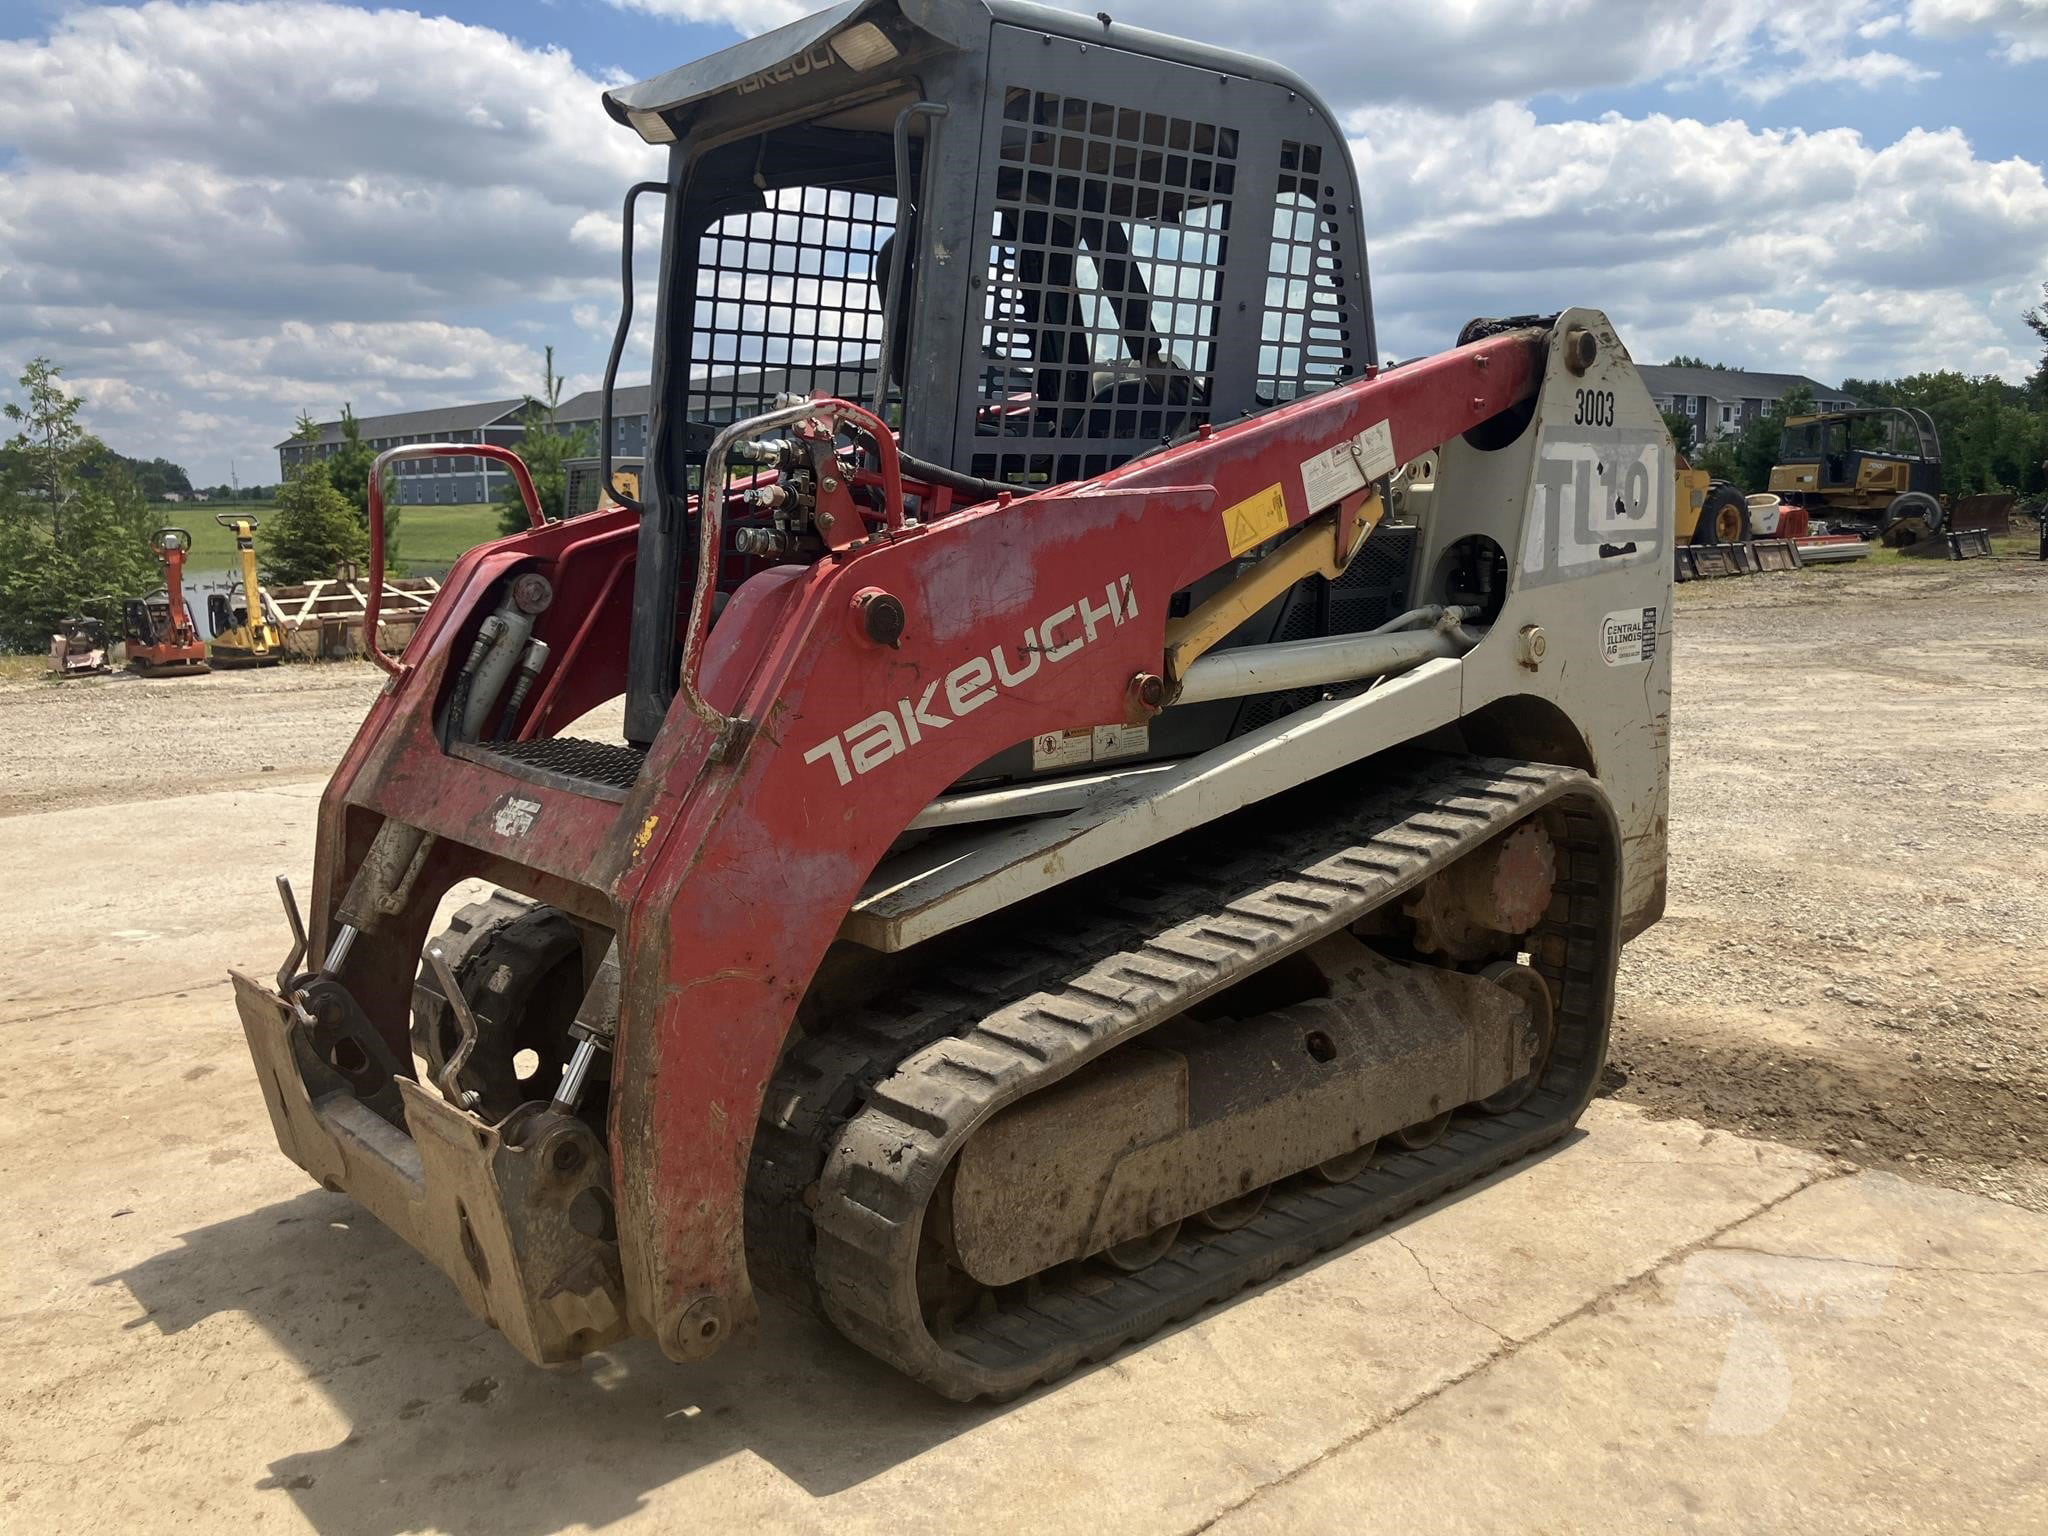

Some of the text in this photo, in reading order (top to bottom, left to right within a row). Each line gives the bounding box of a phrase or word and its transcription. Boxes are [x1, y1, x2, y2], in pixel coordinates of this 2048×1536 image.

[1575, 388, 1615, 427] 3003
[1607, 623, 1642, 636] CENTRAL
[1607, 632, 1642, 645] ILLINOIS
[1607, 645, 1618, 655] AG
[803, 573, 1140, 787] TAKEUCHI
